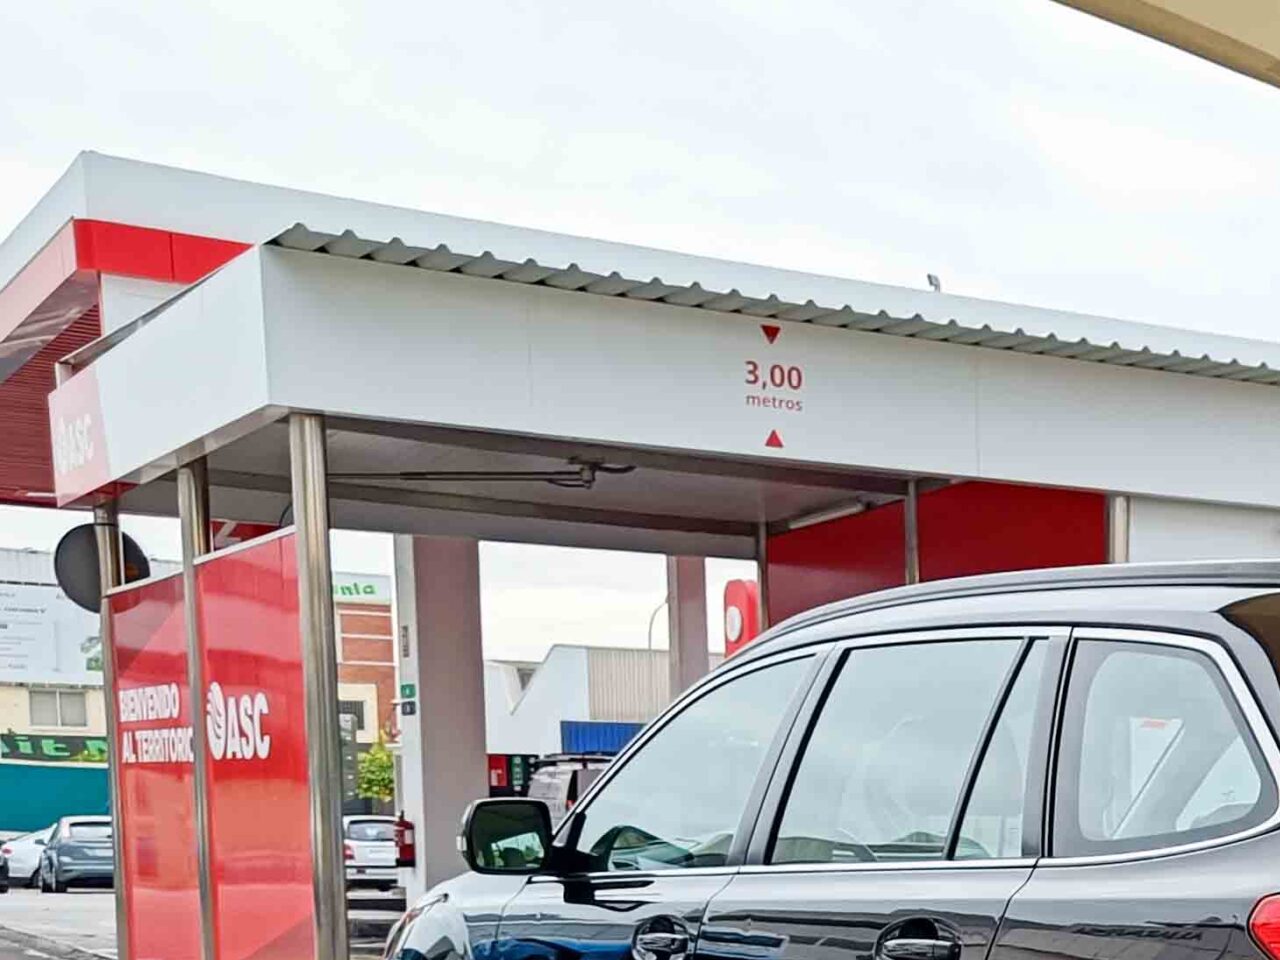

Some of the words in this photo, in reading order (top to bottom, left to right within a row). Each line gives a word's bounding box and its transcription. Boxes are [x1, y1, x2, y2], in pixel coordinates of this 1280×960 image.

[745, 360, 803, 390] 3,00
[745, 394, 803, 411] metros
[226, 692, 270, 760] ASC
[122, 731, 136, 763] AL
